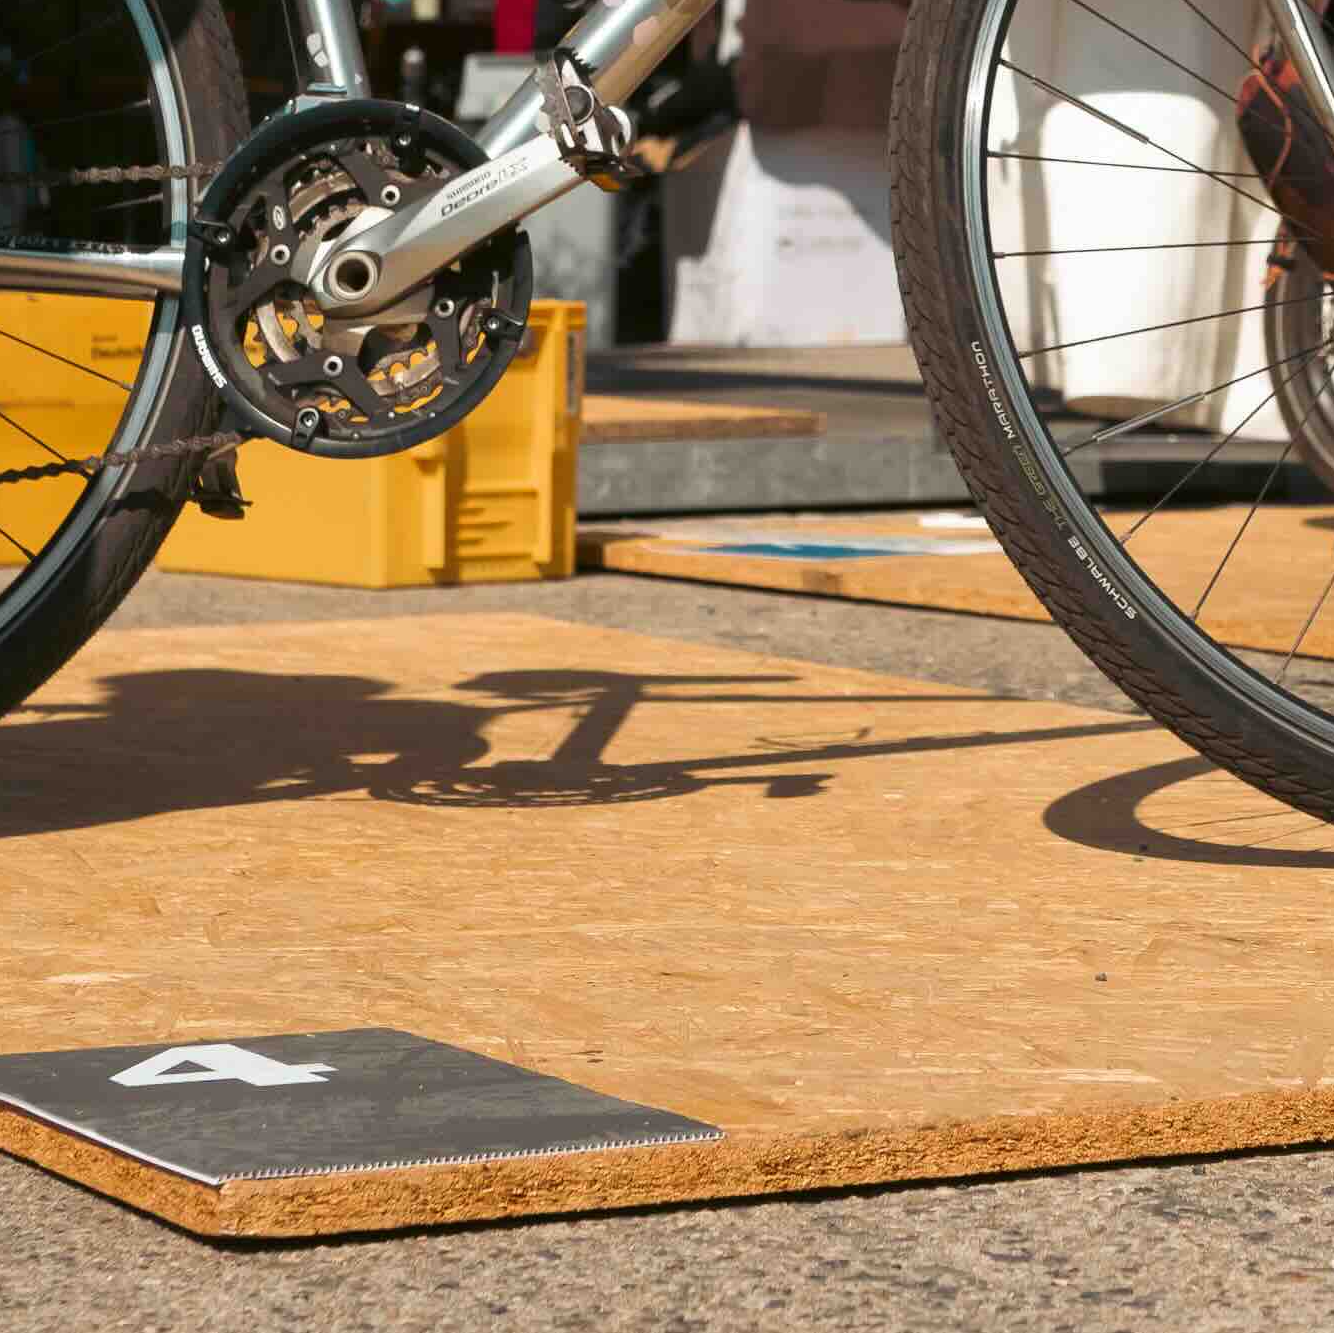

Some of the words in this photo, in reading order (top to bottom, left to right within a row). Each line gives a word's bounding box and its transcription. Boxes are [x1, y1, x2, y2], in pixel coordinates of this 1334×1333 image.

[971, 340, 1016, 441] MARATHON
[1067, 534, 1139, 620] SCHWALBE
[109, 1043, 338, 1088] 4
